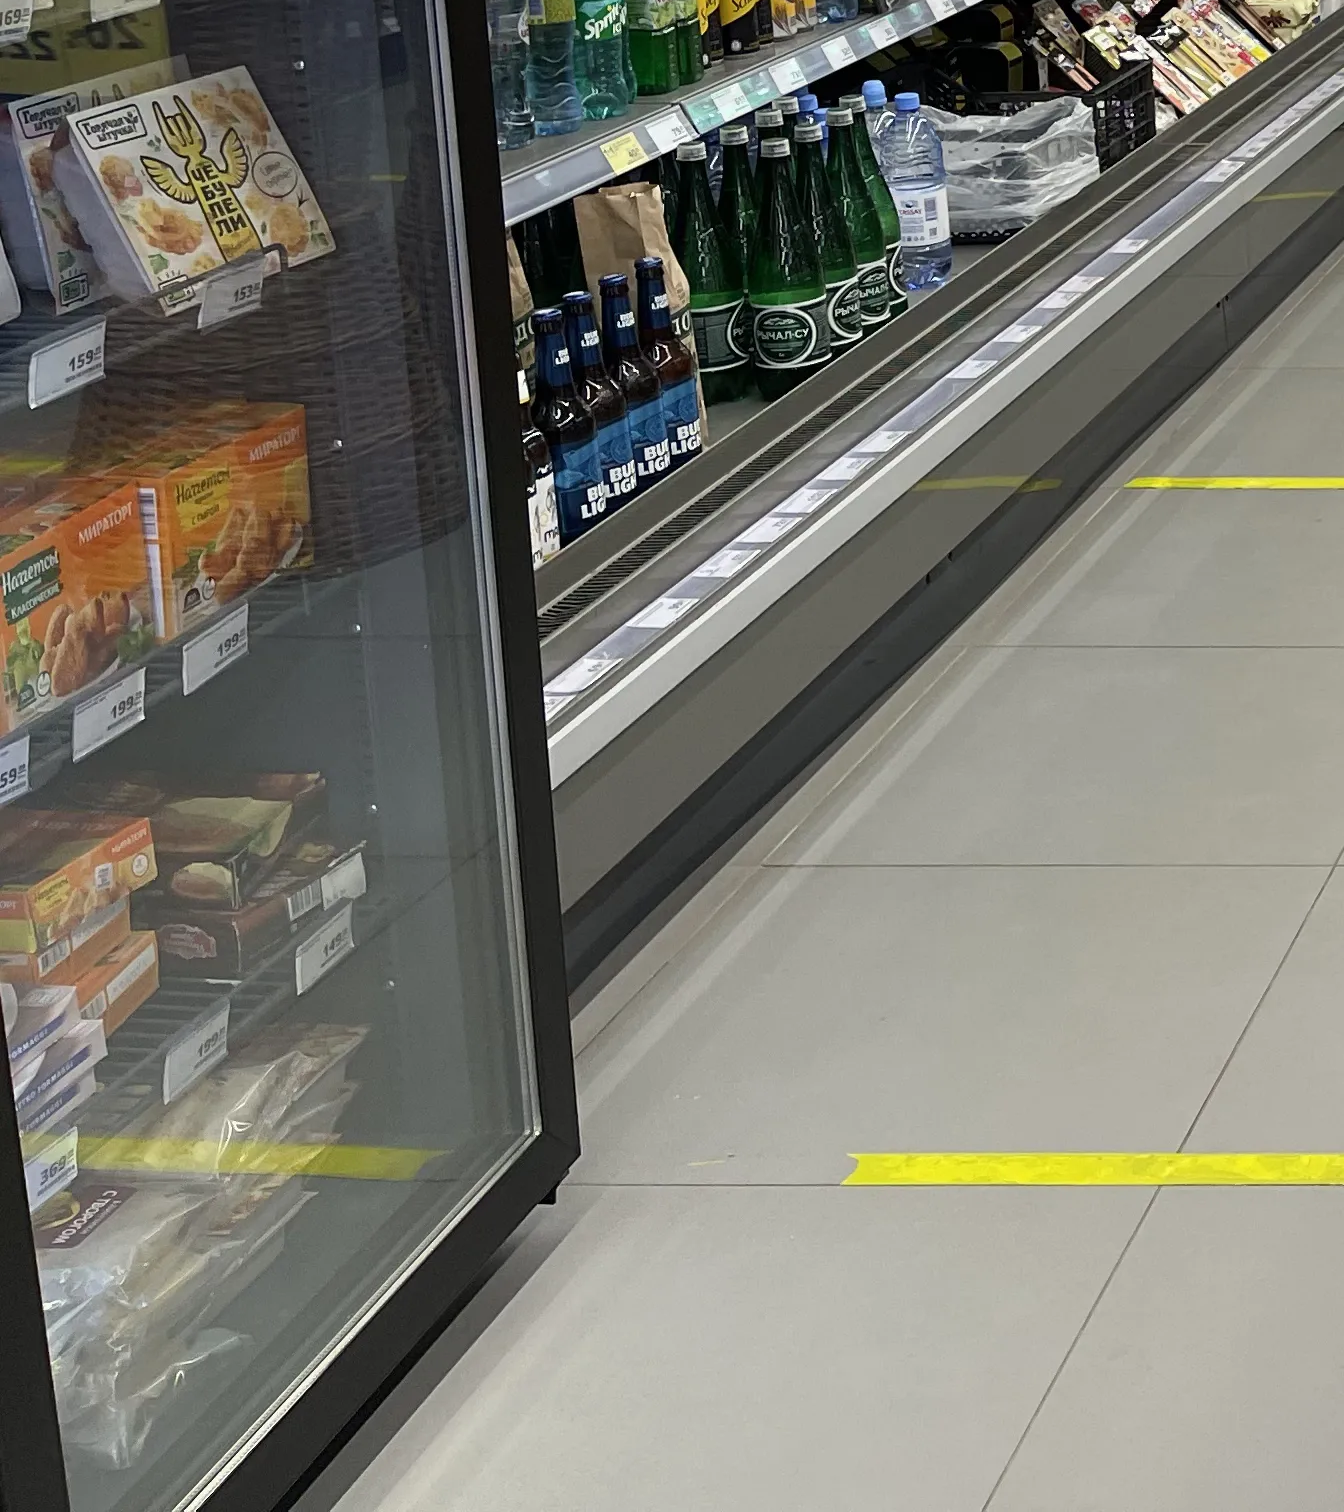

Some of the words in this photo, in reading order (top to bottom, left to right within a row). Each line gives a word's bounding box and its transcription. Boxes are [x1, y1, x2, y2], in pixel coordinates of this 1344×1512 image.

[191, 163, 218, 182] ЧЕ
[203, 180, 228, 201] БУ
[210, 199, 237, 219] ПЕ
[215, 216, 248, 237] ЛИ
[233, 285, 253, 302] 153
[757, 327, 810, 340] РЫЧАЛ-СУ
[68, 350, 94, 372] 159
[250, 426, 300, 463] МИРАТОРГ
[672, 435, 702, 456] LIGH
[638, 455, 671, 476] LIGH
[607, 477, 637, 498] LIGH
[581, 498, 607, 519] LIG
[79, 500, 133, 546] МИРАТОРГ
[2, 551, 59, 595] Наггетсы
[217, 632, 239, 656] 199
[110, 695, 135, 719] 199
[322, 933, 345, 957] 149
[10, 1027, 49, 1059] ORMAGGI
[40, 1159, 66, 1186] 369
